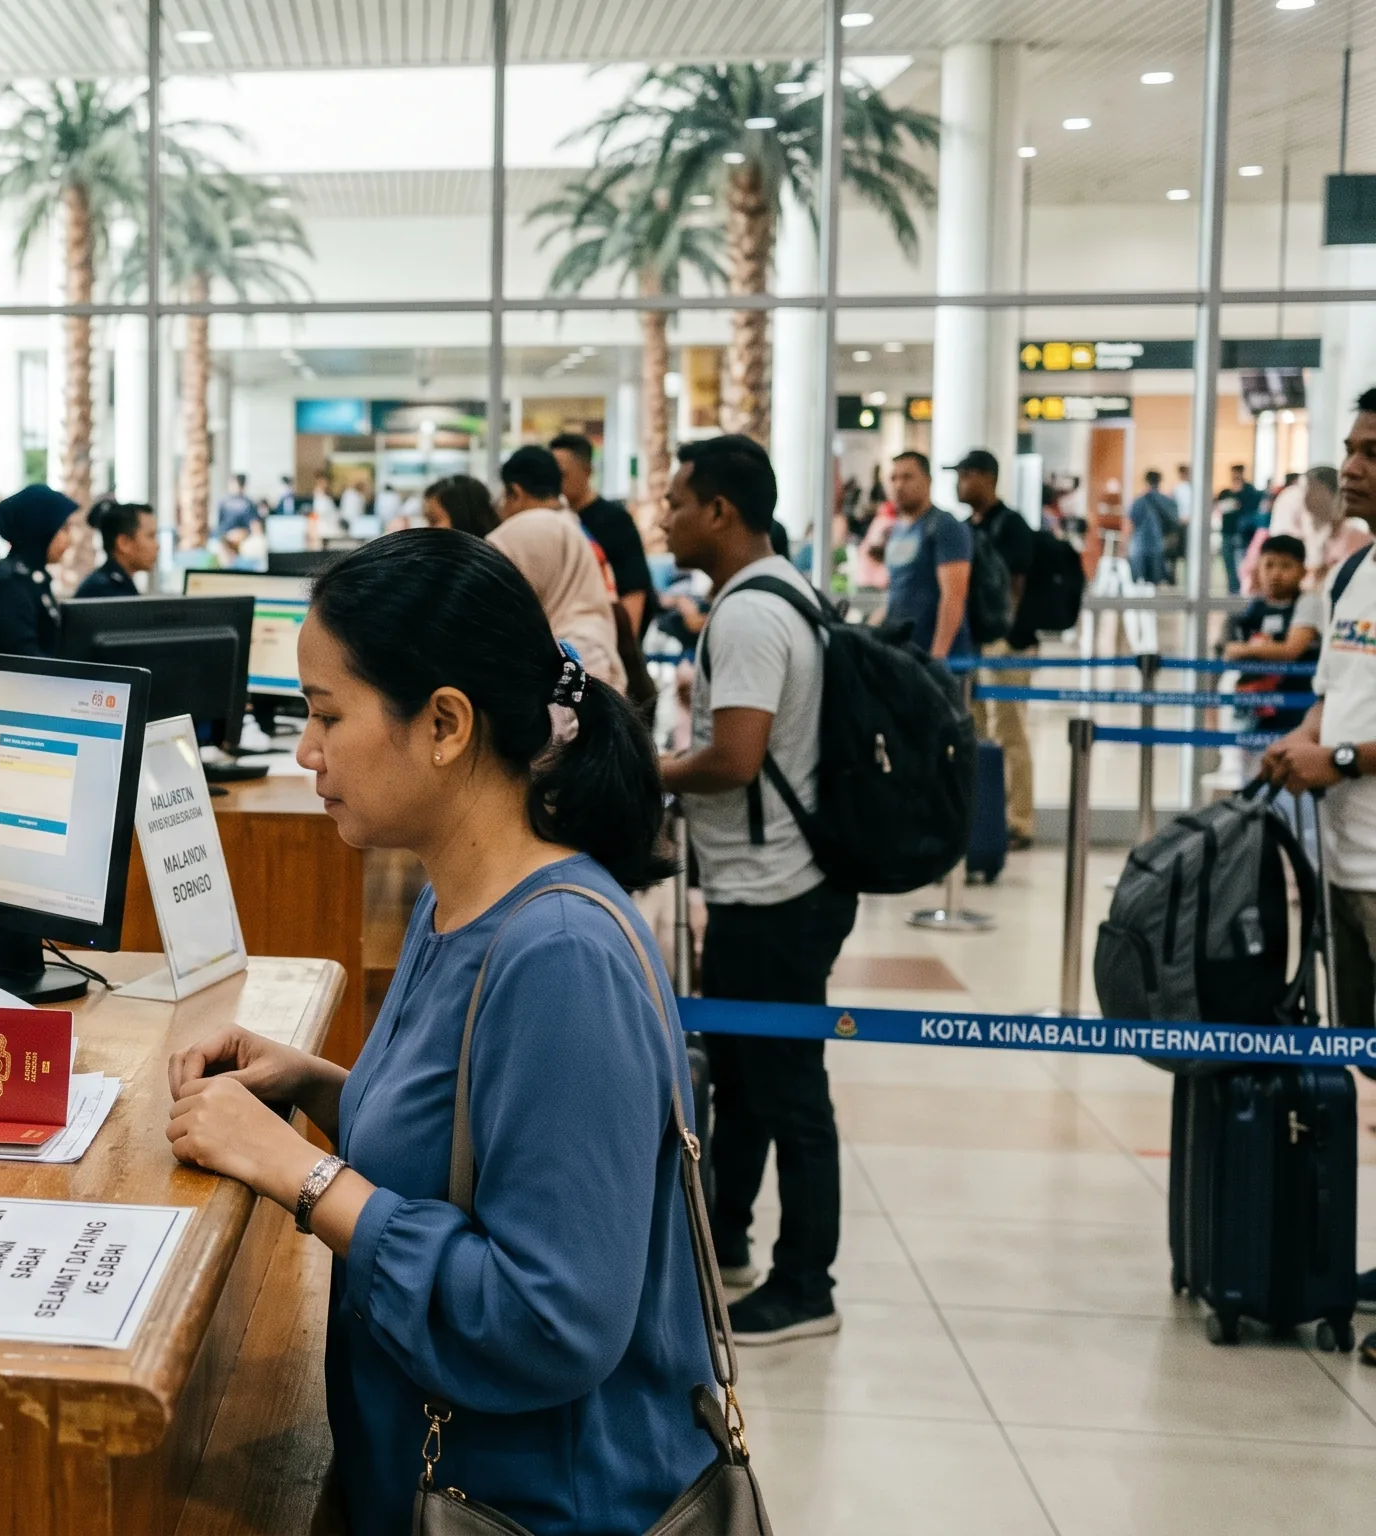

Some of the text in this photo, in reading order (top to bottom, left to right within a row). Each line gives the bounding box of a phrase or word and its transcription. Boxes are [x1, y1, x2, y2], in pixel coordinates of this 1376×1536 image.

[921, 1018, 982, 1042] KOTA
[989, 1022, 1106, 1048] KINABALU
[1113, 1026, 1302, 1056] INTERNATIONAL
[34, 1267, 81, 1319] SELAMAT
[83, 1280, 110, 1295] KE
